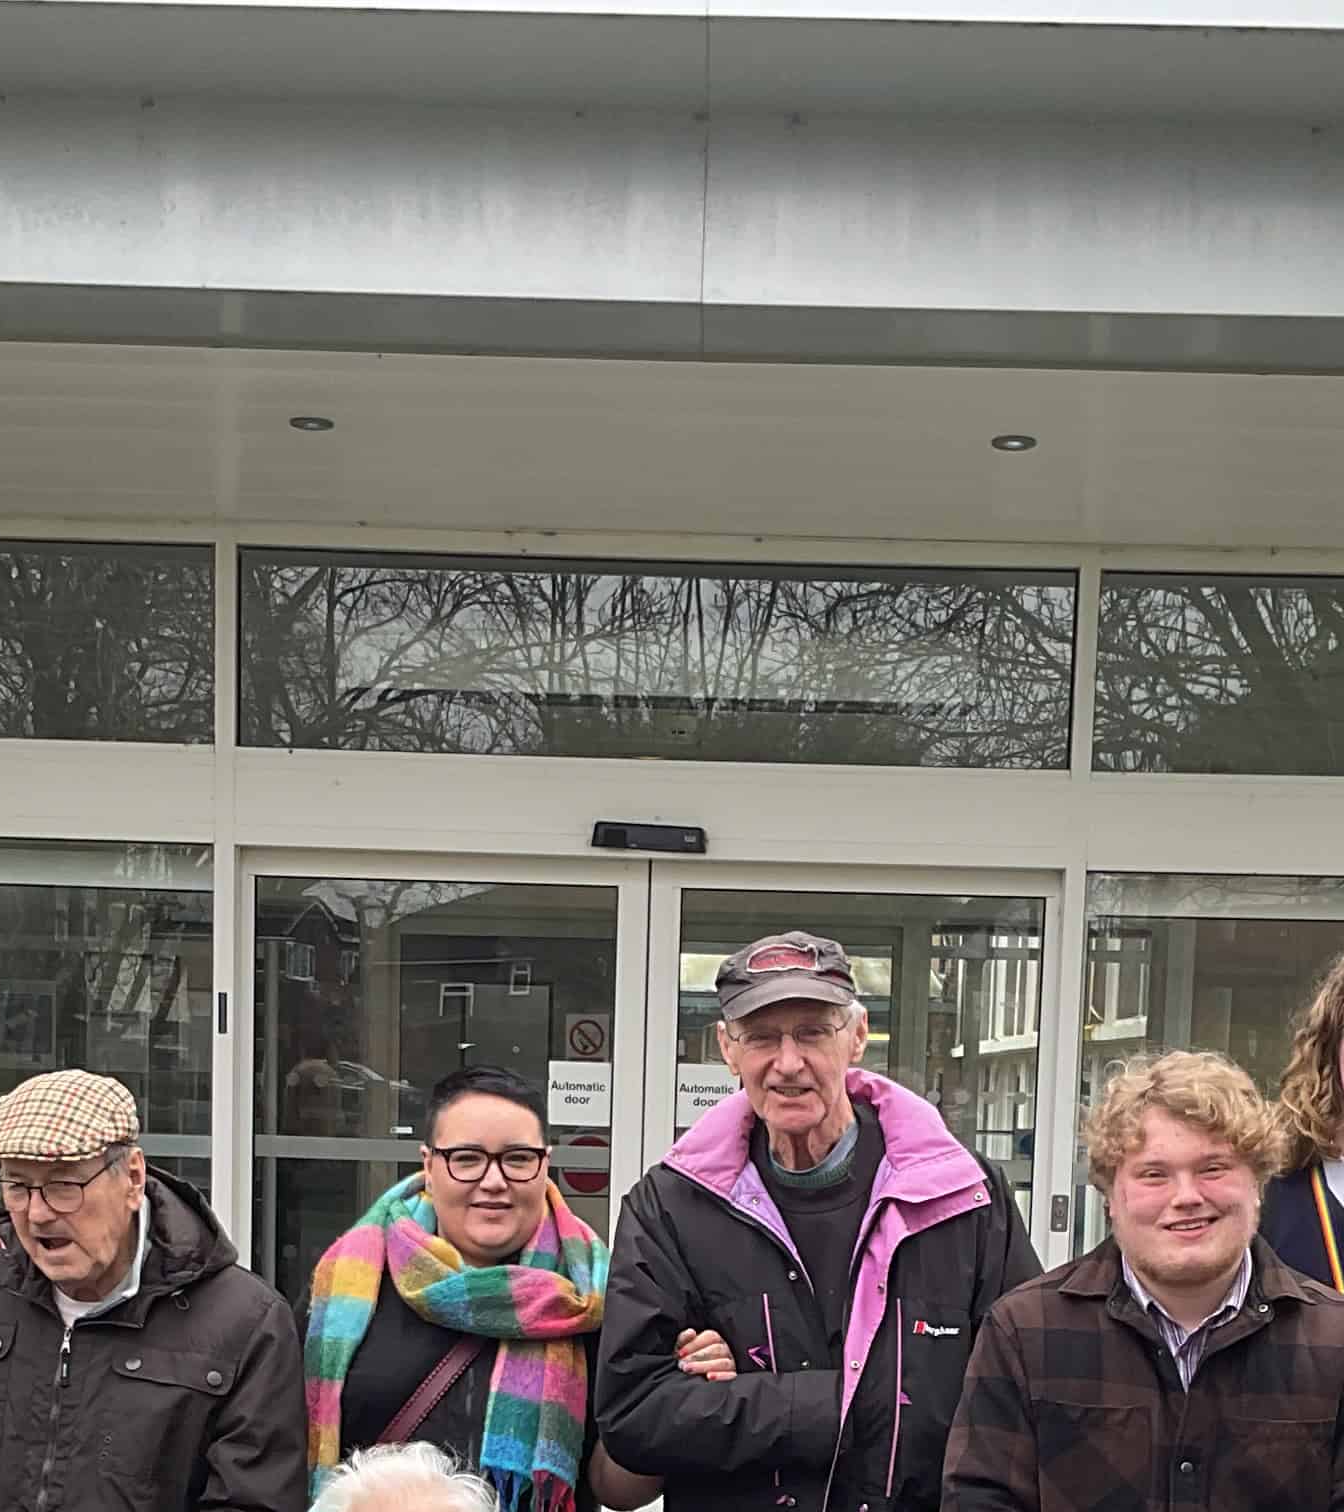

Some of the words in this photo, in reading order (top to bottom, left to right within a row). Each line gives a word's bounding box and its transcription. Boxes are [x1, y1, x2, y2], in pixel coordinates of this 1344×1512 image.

[551, 1080, 606, 1093] Automatic
[679, 1083, 734, 1094] Automatic
[564, 1094, 590, 1104] door
